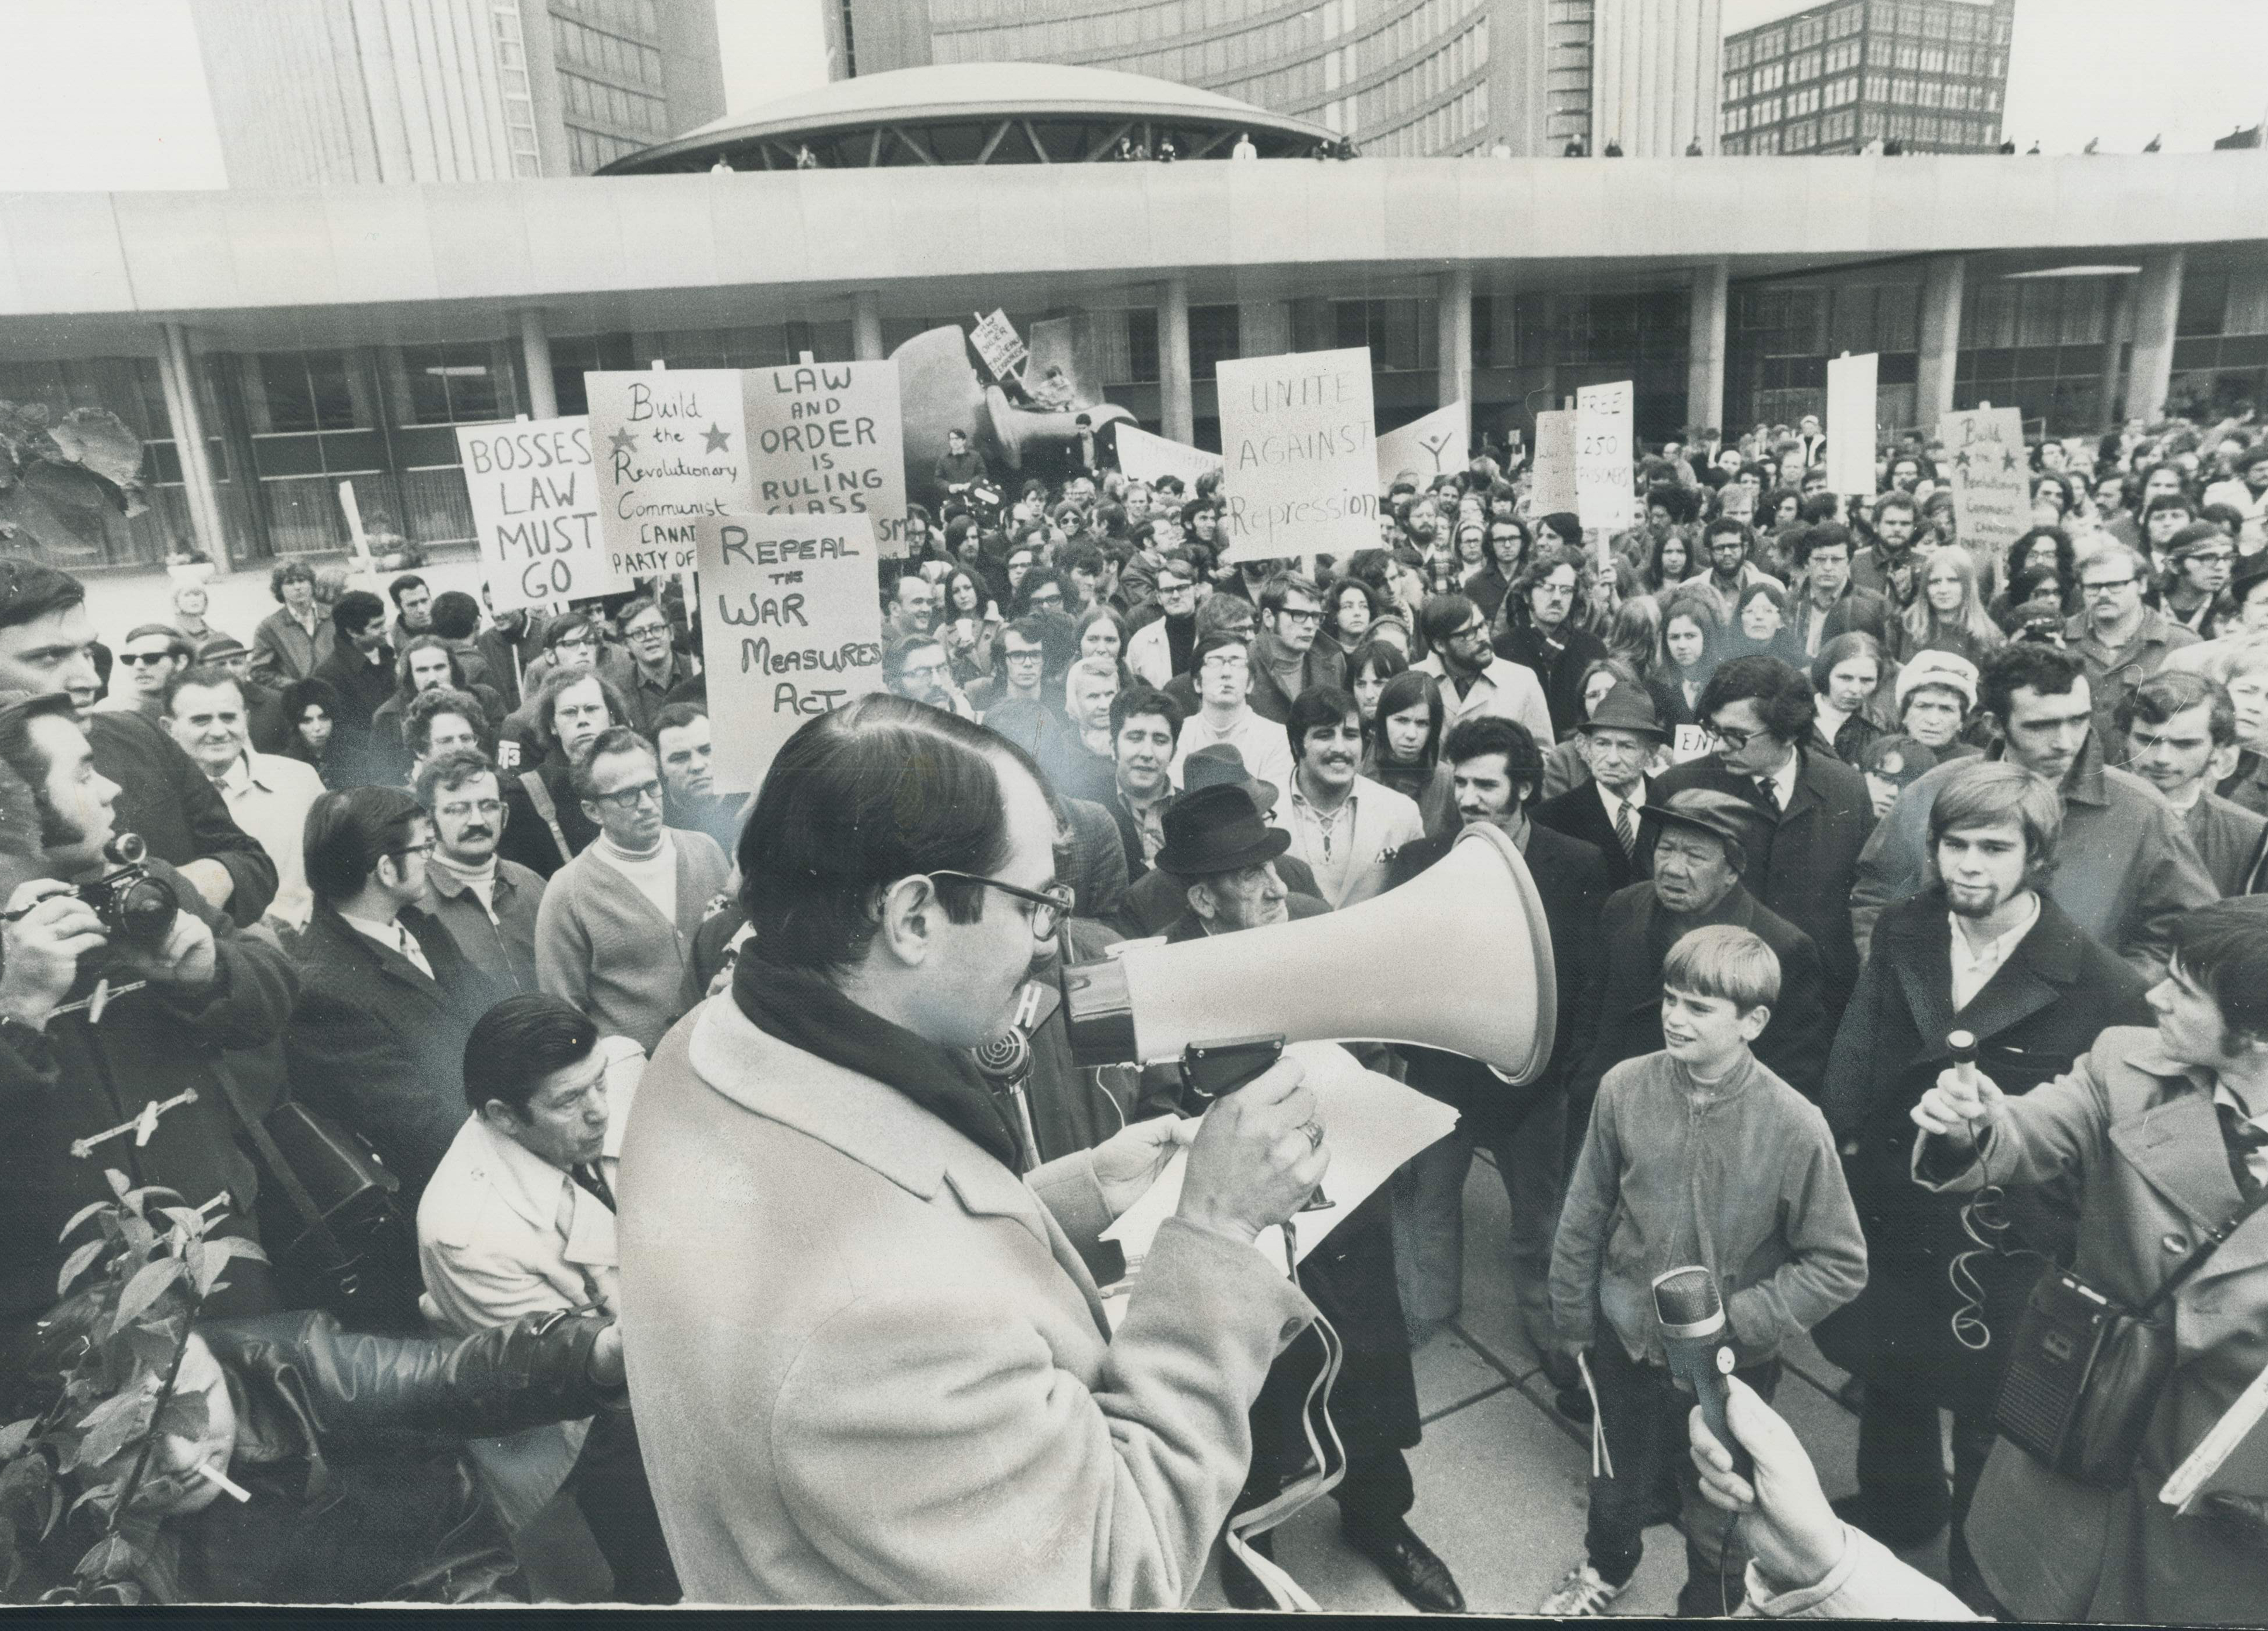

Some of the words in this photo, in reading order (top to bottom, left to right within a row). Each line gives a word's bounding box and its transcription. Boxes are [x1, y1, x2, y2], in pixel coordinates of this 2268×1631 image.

[773, 367, 851, 394] LAW
[1252, 373, 1355, 413] UNITE
[627, 383, 701, 422] Build
[791, 398, 840, 420] AND
[469, 428, 592, 474] BOSSES
[653, 428, 683, 443] the
[760, 416, 876, 454] ORDER
[1239, 421, 1372, 471] AGAINST
[1584, 435, 1618, 456] 250
[609, 449, 736, 485] Revolutionary
[812, 453, 834, 471] IS
[500, 472, 575, 515] LAW
[761, 467, 882, 501] RULING
[618, 491, 729, 519] Communist
[1231, 489, 1377, 543] Repression
[497, 512, 598, 561] MUST
[719, 525, 859, 566] REPEAL
[522, 559, 572, 598] GO
[612, 550, 668, 573] PARTY
[676, 549, 695, 567] OF
[719, 592, 808, 627] WAR
